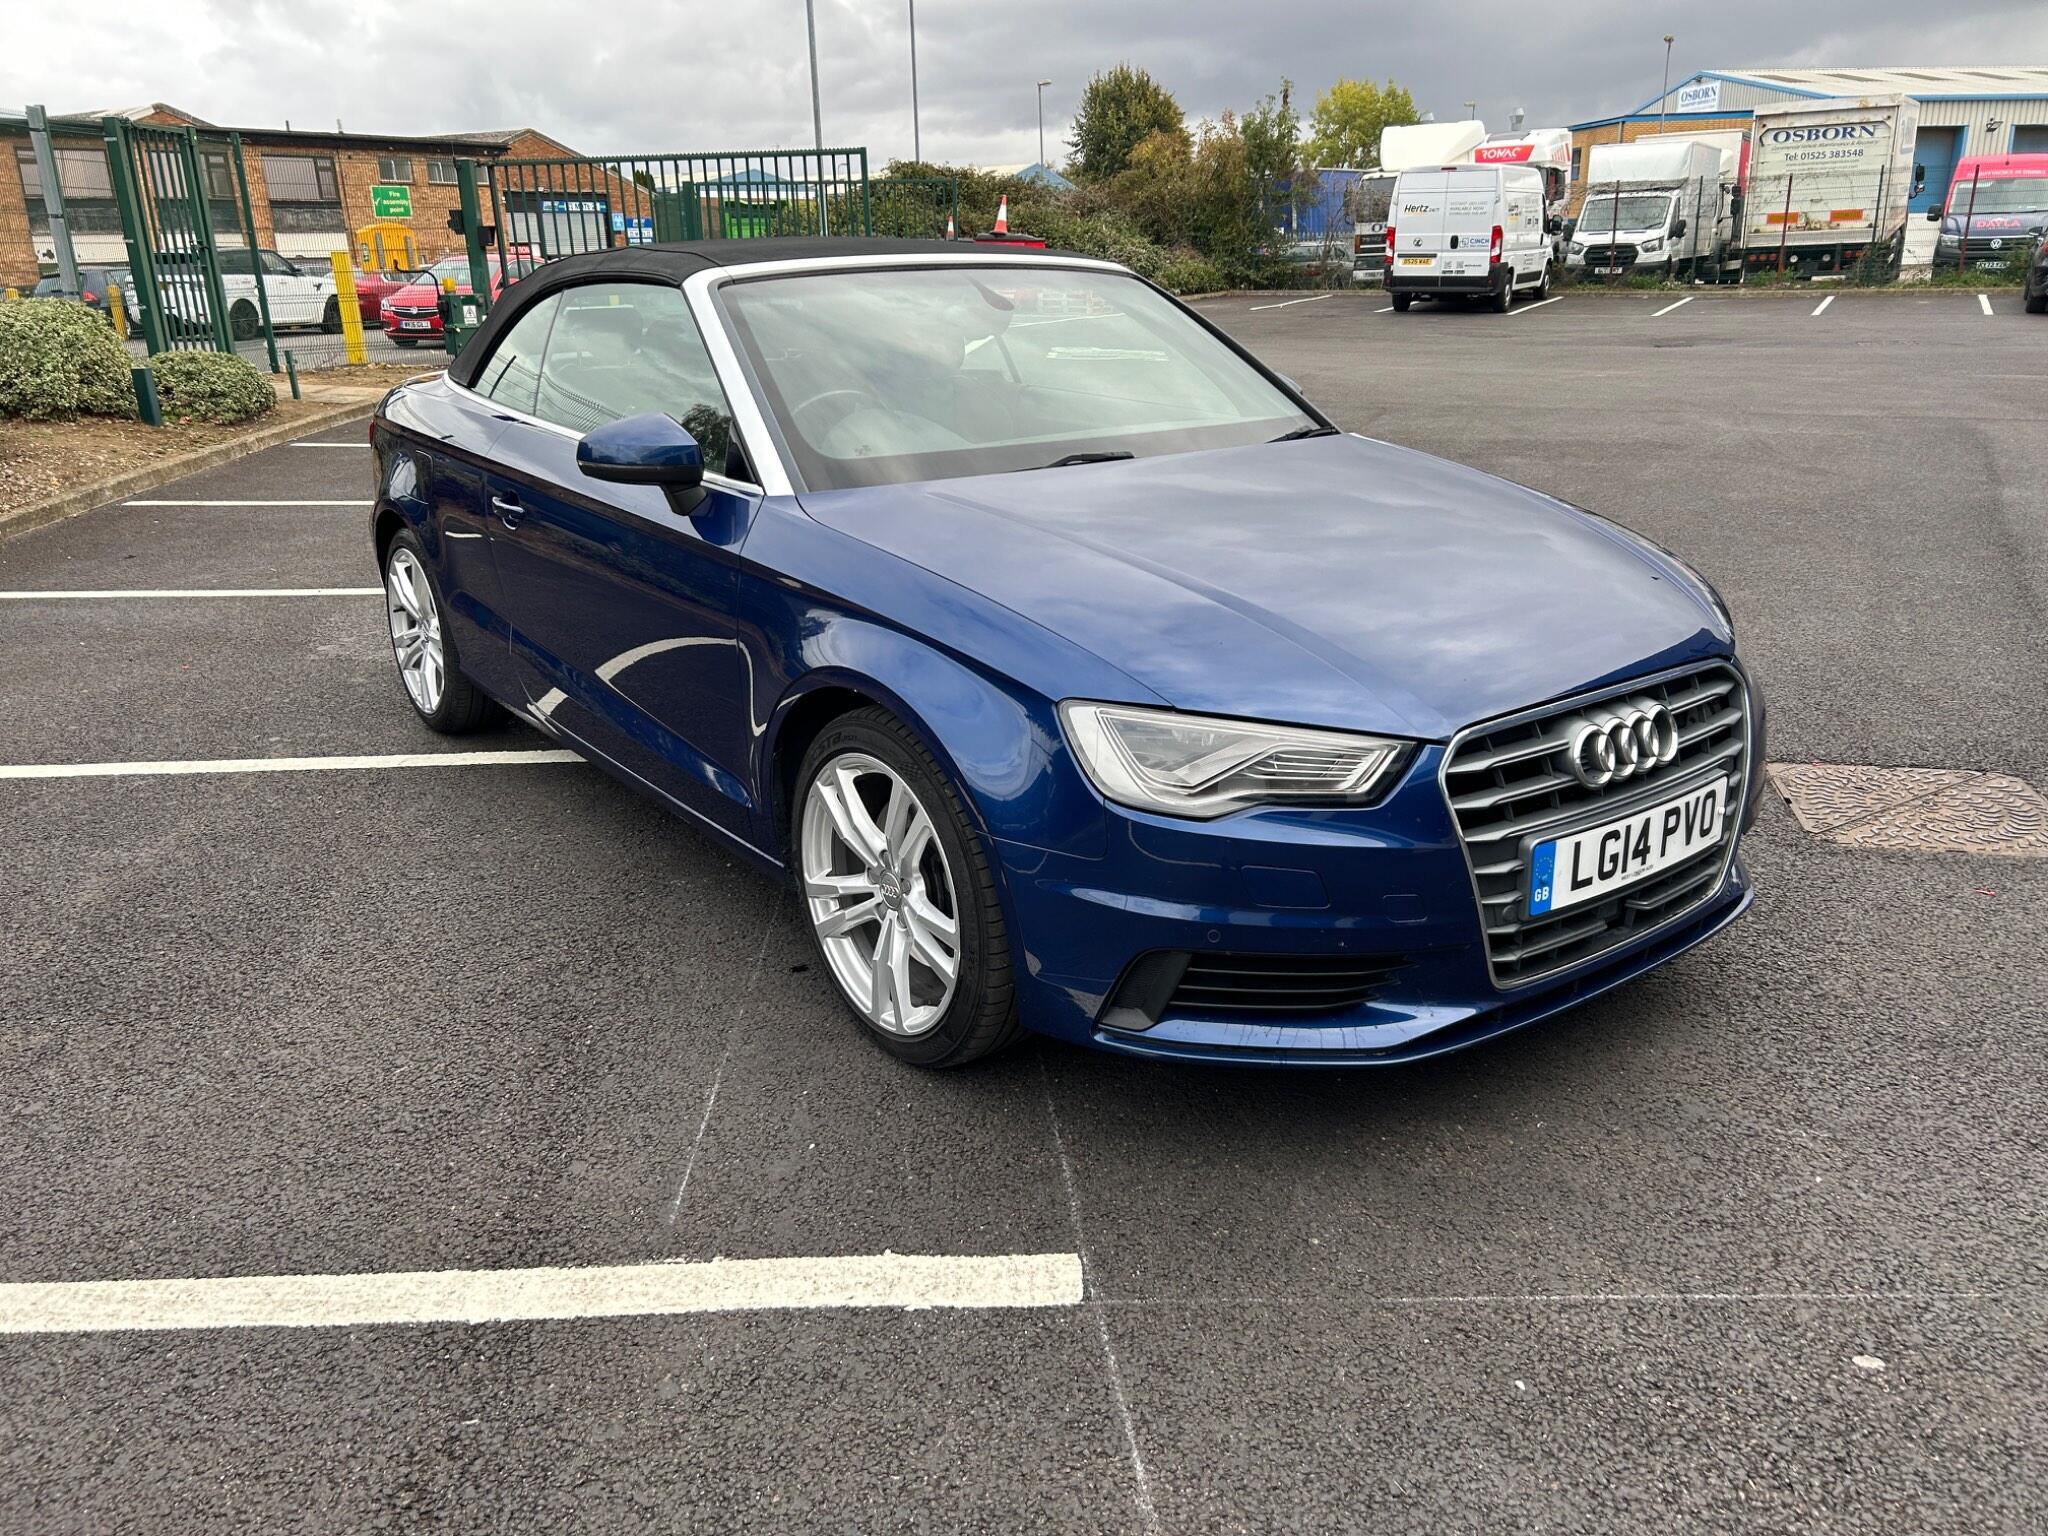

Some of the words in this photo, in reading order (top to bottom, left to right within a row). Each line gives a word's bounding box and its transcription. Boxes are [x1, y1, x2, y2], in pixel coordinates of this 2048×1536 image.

[1681, 86, 1718, 103] OSBORN
[1773, 124, 1879, 143] OSBORN
[1785, 152, 1798, 161] Tel:
[1801, 151, 1826, 160] 01525
[1829, 149, 1864, 159] 383548
[1404, 204, 1429, 213] Hertz
[1570, 816, 1652, 892] LG14
[1660, 789, 1717, 858] PVO
[1534, 886, 1550, 902] GB
